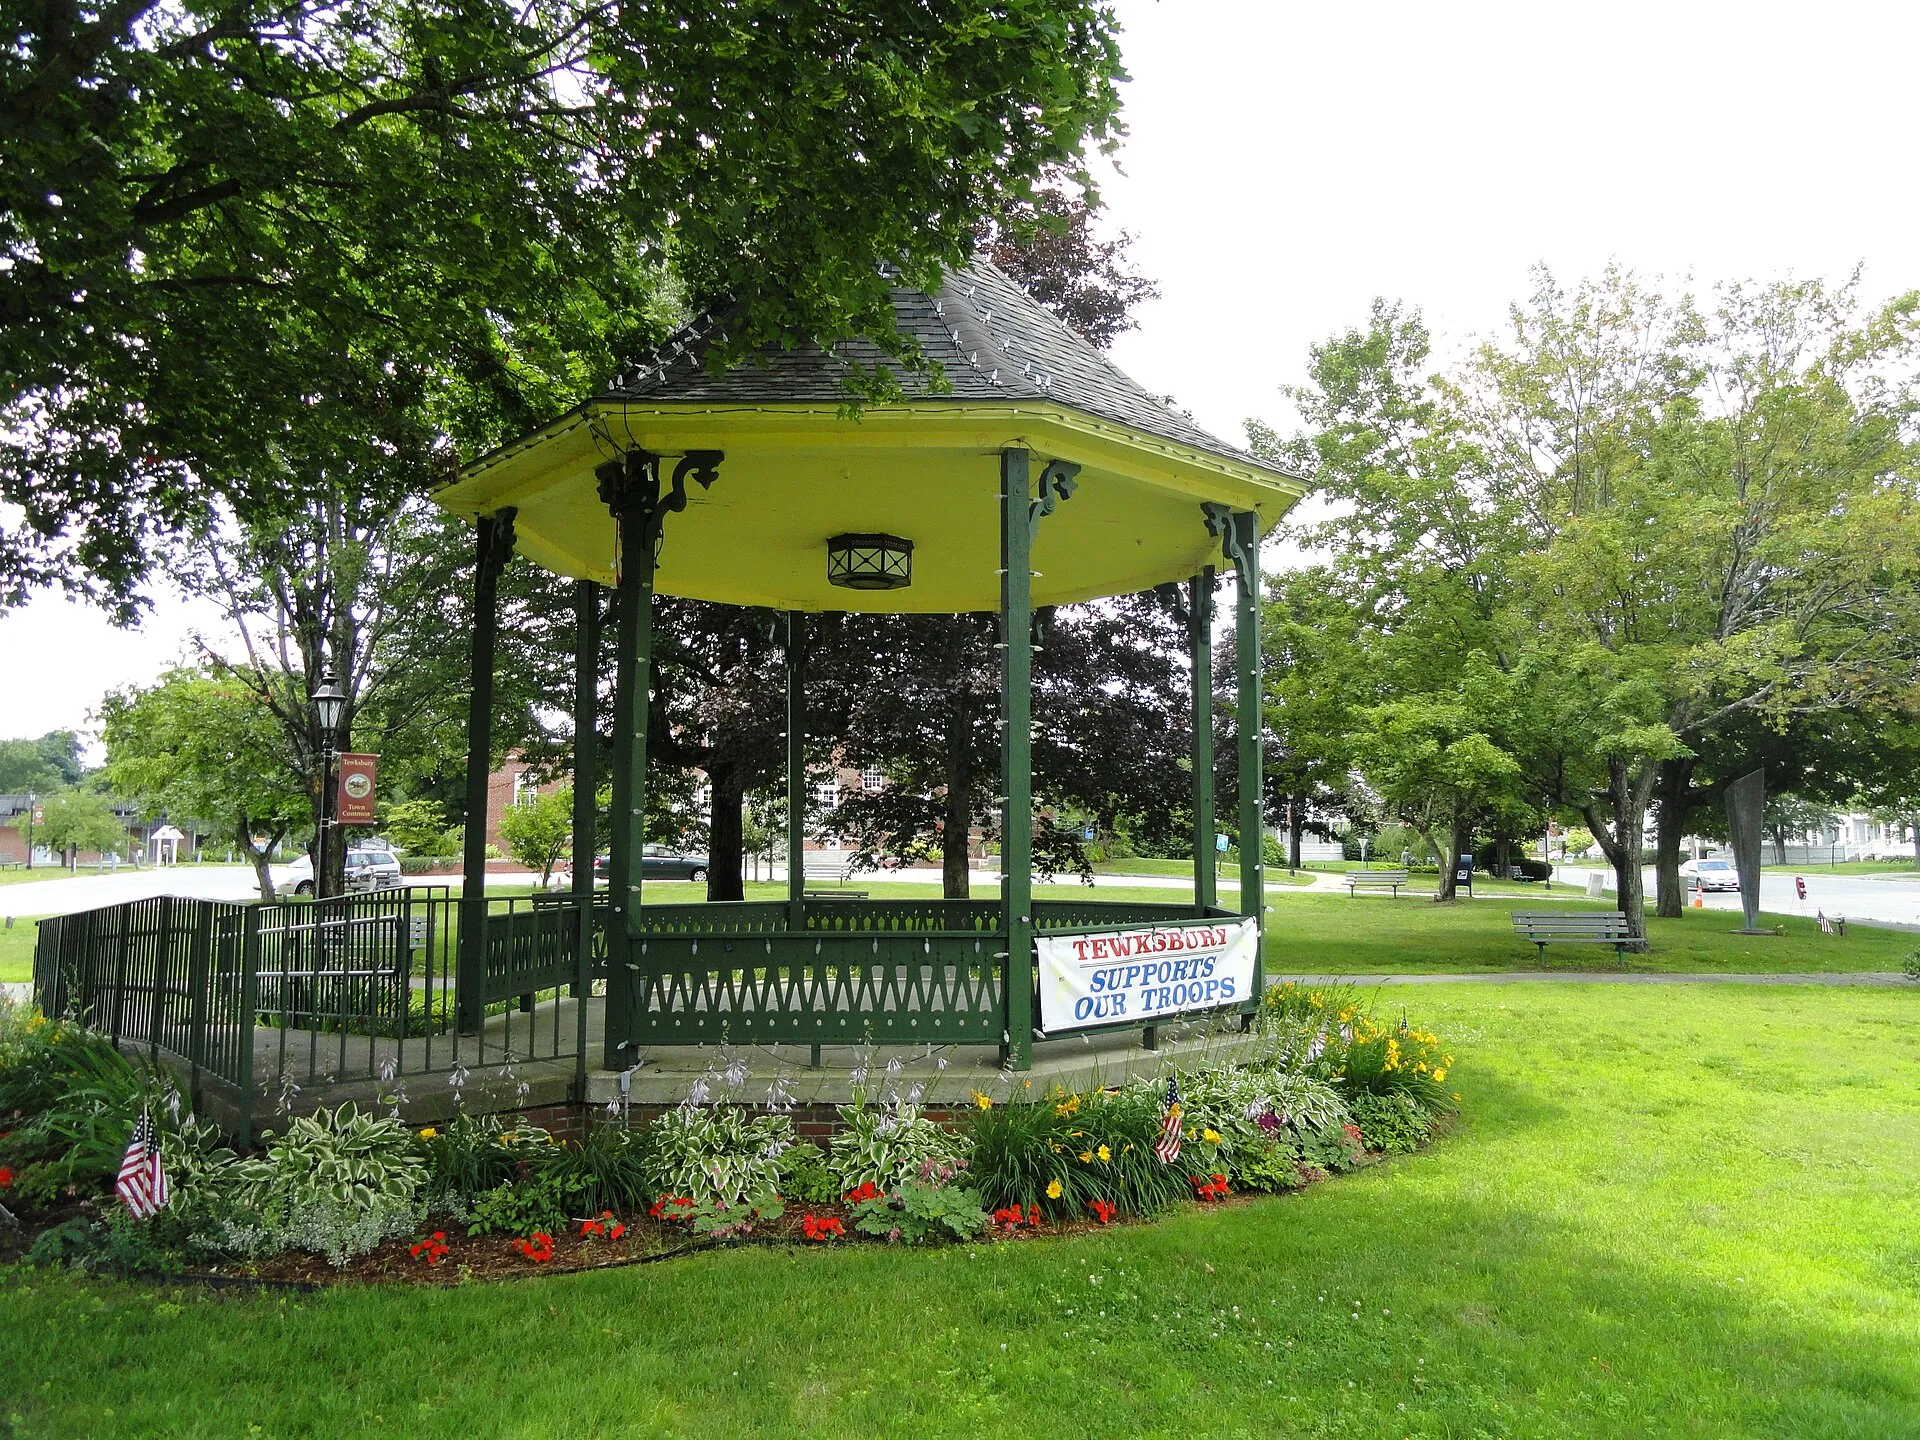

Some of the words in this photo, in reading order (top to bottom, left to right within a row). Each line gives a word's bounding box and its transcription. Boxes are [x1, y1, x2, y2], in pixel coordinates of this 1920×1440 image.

[343, 759, 375, 768] Tewksbury
[1072, 928, 1227, 960] TEWKSBURY
[1090, 956, 1217, 993] SUPPORTS
[1074, 992, 1127, 1020] OUR
[1140, 977, 1235, 1011] TROOPS
